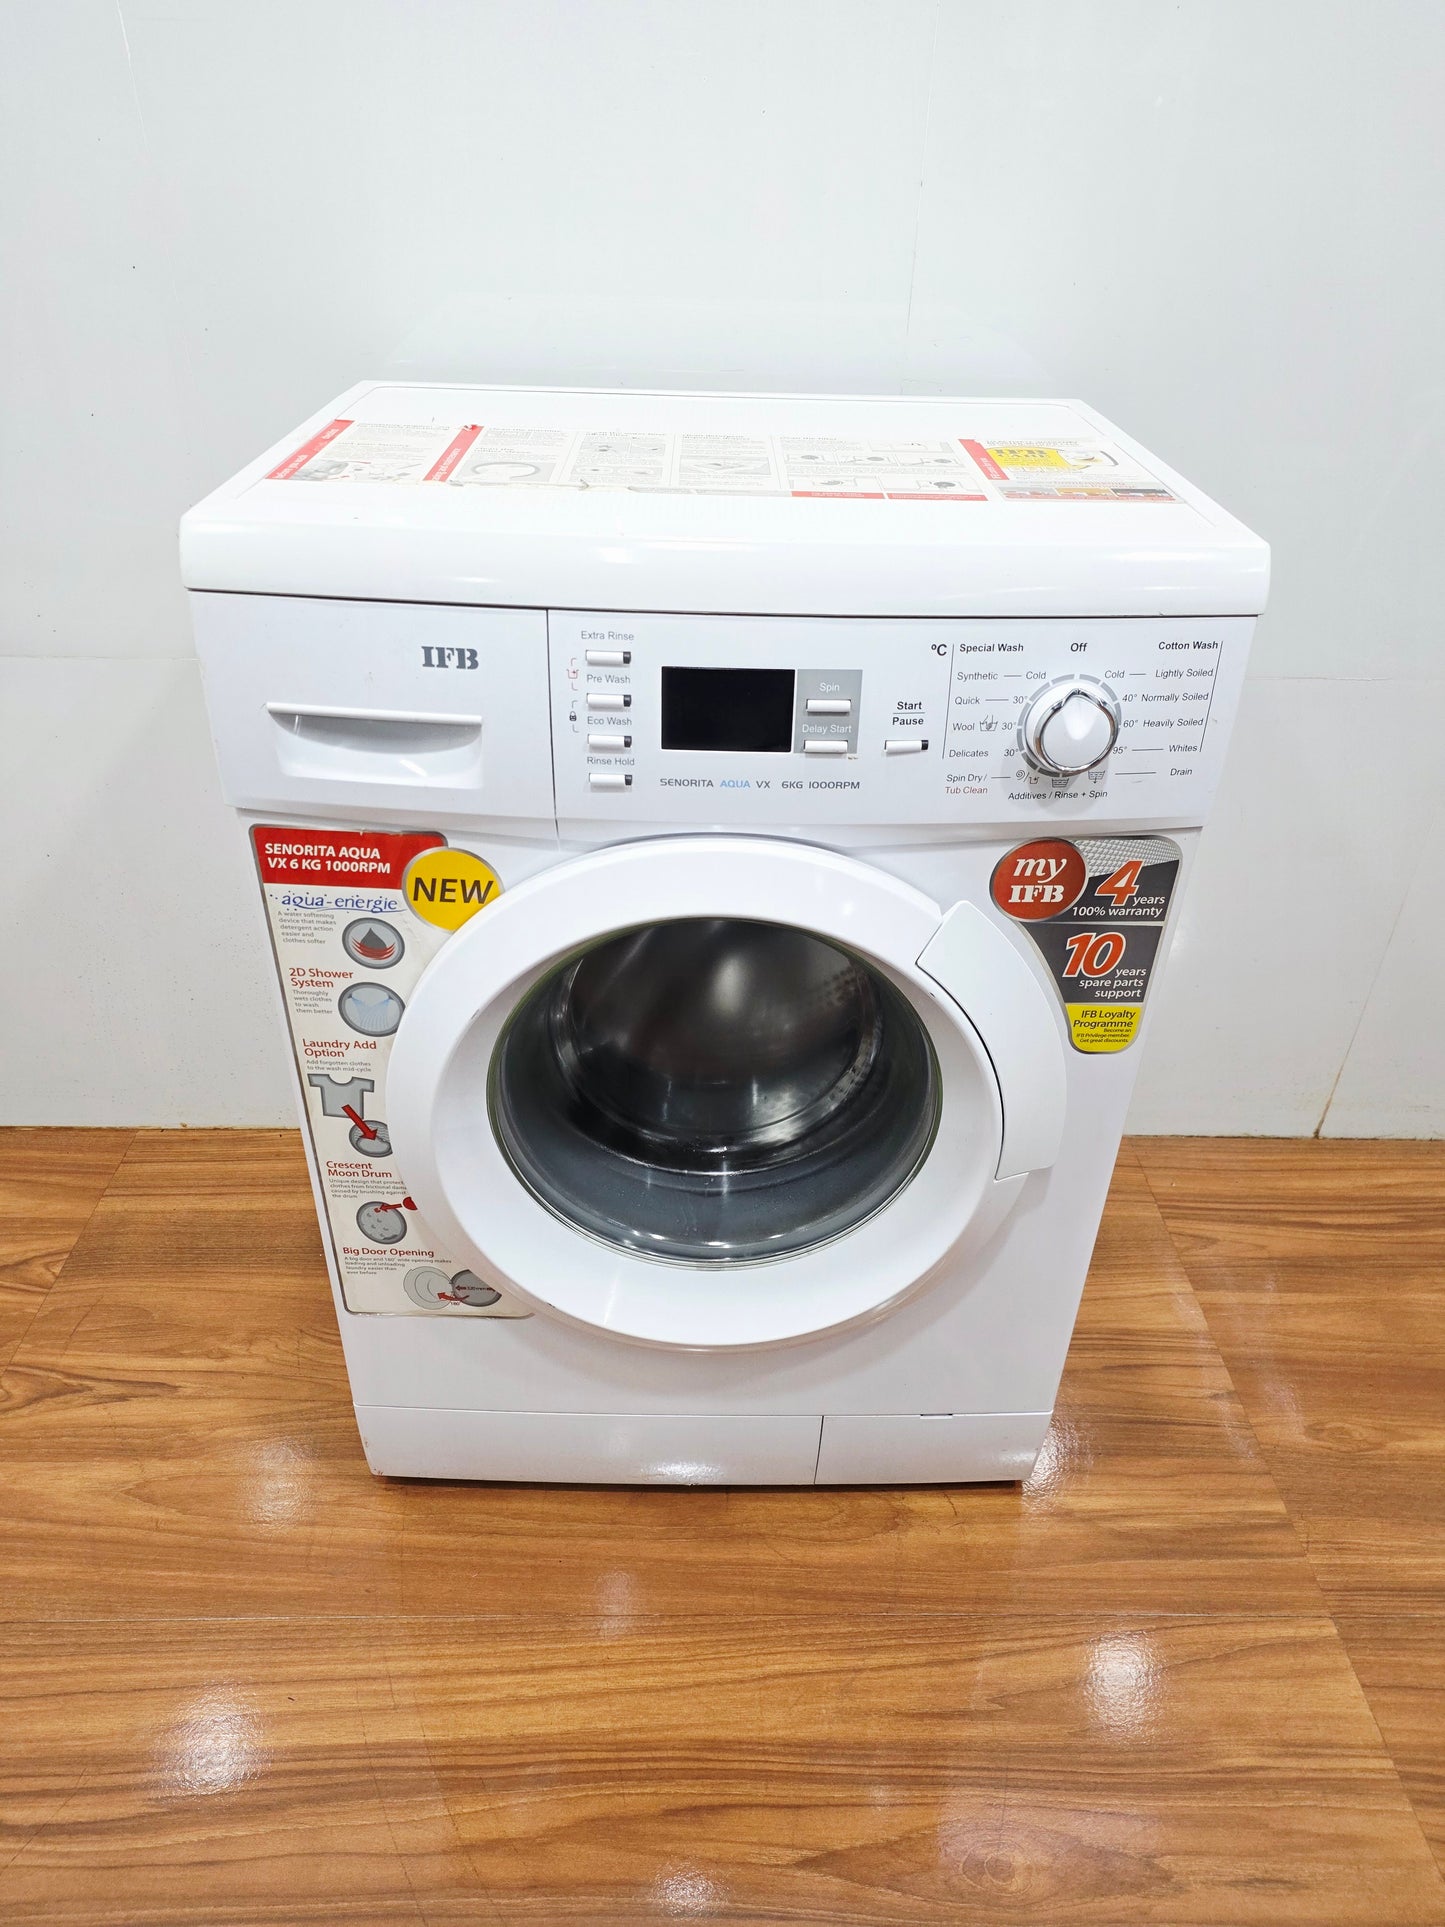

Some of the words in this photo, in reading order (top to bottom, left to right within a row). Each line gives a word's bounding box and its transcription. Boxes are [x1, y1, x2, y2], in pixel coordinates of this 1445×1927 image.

[581, 631, 604, 640] Extra
[608, 632, 634, 641] Rinse
[960, 644, 994, 653] Special
[998, 644, 1024, 652] Wash
[1070, 643, 1088, 652] Off
[1158, 641, 1189, 650] Cotton
[1193, 641, 1218, 649] Wash
[422, 646, 478, 670] IFB
[957, 672, 998, 682] Synthetic
[1026, 671, 1046, 679] Cold
[1104, 670, 1125, 679] Cold
[1156, 669, 1184, 679] Lightly
[1186, 668, 1213, 677] Soiled
[586, 674, 602, 683] Pre
[605, 675, 630, 684] Wash
[819, 682, 840, 693] Spin
[955, 697, 980, 705] Quick
[1142, 693, 1179, 703] Normally
[1182, 693, 1209, 701] Soiled
[897, 701, 922, 711] Start
[587, 716, 604, 725] Eco
[607, 717, 632, 726] Wash
[892, 717, 924, 726] Pause
[1143, 719, 1174, 728] Heavily
[802, 724, 827, 734] Delay
[830, 725, 852, 733] Start
[949, 749, 989, 758] Delicates
[587, 757, 612, 765] Rinse
[615, 758, 635, 766] Hold
[660, 778, 714, 788] SENORITA
[720, 779, 750, 788] AQUA
[756, 780, 770, 788] VX
[781, 780, 803, 789] 6KG
[946, 774, 966, 783] Spin
[945, 786, 961, 794] Tub
[1008, 792, 1046, 800] Additives
[265, 843, 336, 857] SENORITA
[339, 847, 380, 860] AQUA
[268, 857, 287, 869] VX
[290, 859, 299, 869] 6
[302, 859, 321, 871] KG
[326, 860, 391, 874] 1000RPM
[1013, 858, 1067, 883] my
[1094, 860, 1144, 906] 4
[1133, 895, 1165, 906] years
[412, 877, 494, 904] NEW
[1008, 885, 1064, 903] IFB
[1072, 906, 1106, 916] 100%
[1108, 907, 1162, 918] warranty
[1062, 932, 1126, 978] 10
[1115, 967, 1146, 978] years
[289, 968, 306, 976] 2D
[309, 968, 353, 978] Shower
[291, 978, 334, 988] System
[1079, 979, 1111, 988] spare
[1113, 978, 1144, 988] parts
[1095, 988, 1141, 1000] support
[1099, 1010, 1136, 1020] Loyalty
[1073, 1020, 1133, 1029] Programme
[303, 1039, 350, 1050] Laundry
[354, 1040, 377, 1049] Add
[304, 1048, 345, 1058] Option
[326, 1161, 372, 1169] Crescent
[343, 1247, 359, 1256] Big
[390, 1248, 434, 1258] Opening
